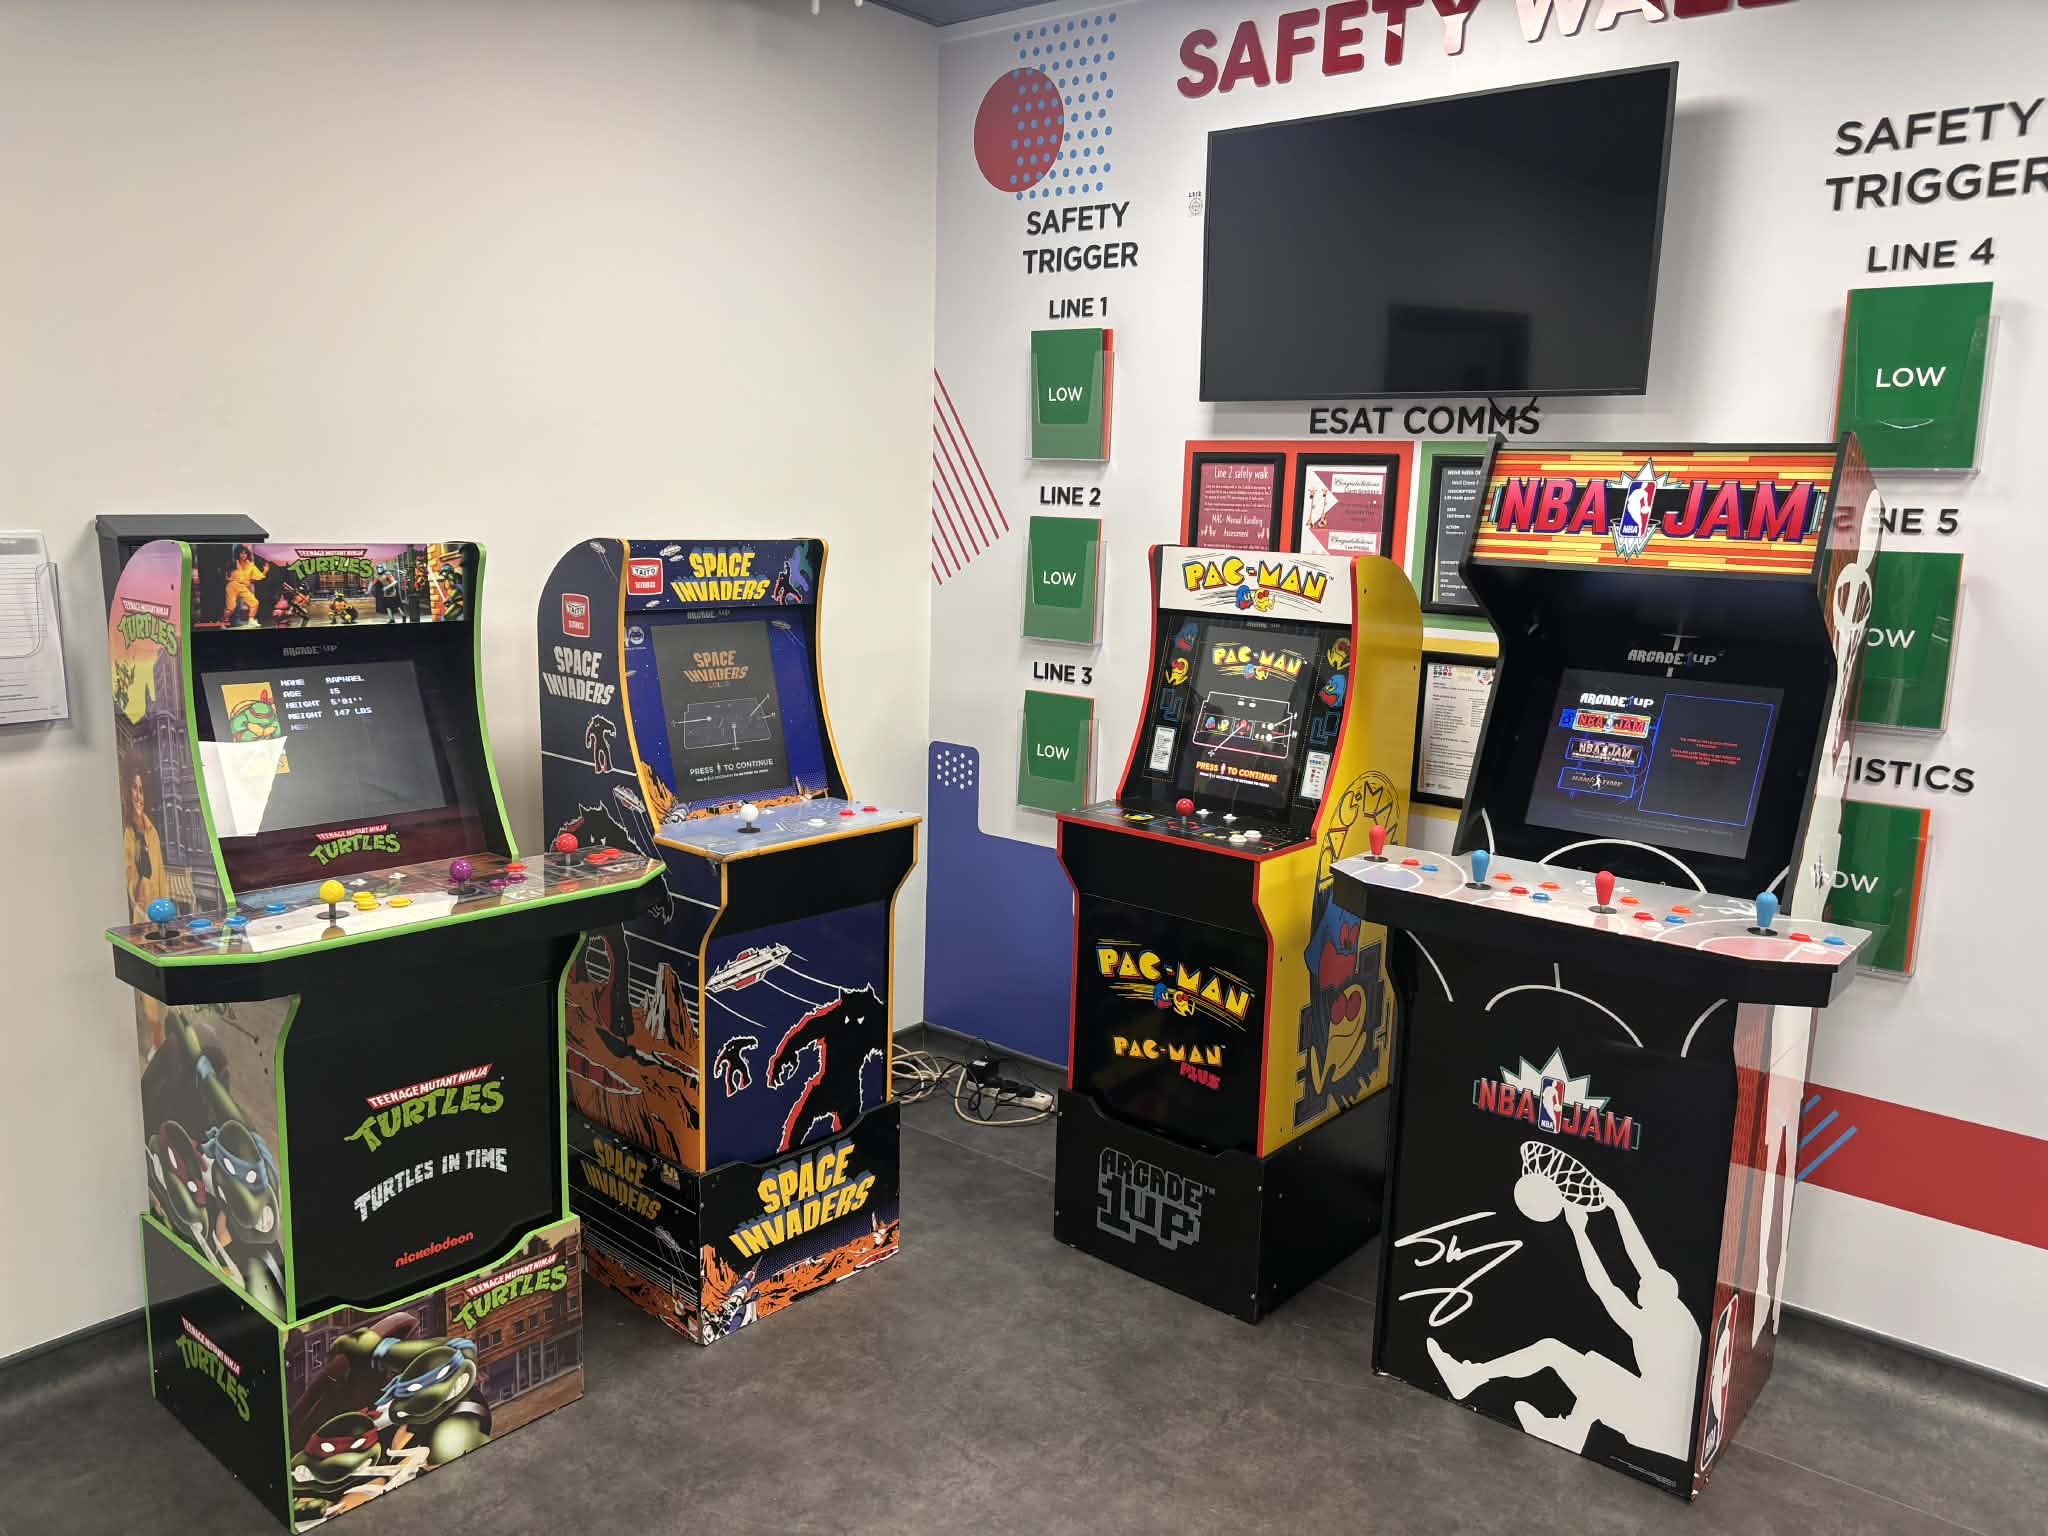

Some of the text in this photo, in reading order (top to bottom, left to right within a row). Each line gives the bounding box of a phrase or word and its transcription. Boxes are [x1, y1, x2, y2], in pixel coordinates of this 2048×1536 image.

[1177, 0, 1480, 99] SAFETY
[1835, 98, 2045, 156] SAFETY
[1826, 156, 2048, 212] TRIGGER
[1026, 202, 1130, 236] SAFETY
[1023, 242, 1139, 274] TRIGGER
[1868, 237, 1994, 272] LINE 4
[1049, 297, 1108, 319] LINE 1
[1876, 366, 1946, 388] LOW
[1048, 387, 1082, 402] LOW
[1309, 406, 1540, 435] ESAT COMMS
[1040, 486, 1101, 506] LINE 2
[1497, 478, 1815, 544] NBA JAM
[1622, 525, 1639, 534] NBA
[1937, 508, 1959, 534] 5
[288, 556, 374, 580] TURTLES
[634, 568, 656, 577] TAITO
[688, 551, 756, 578] SPACE
[1043, 571, 1076, 586] LOW
[1182, 556, 1327, 603] PAC-MAN
[670, 578, 771, 603] INVADERS
[117, 612, 178, 657] TURTLES
[1866, 628, 1916, 649] OW
[553, 645, 603, 678] SPACE
[683, 666, 749, 683] INVADERS
[693, 650, 737, 668] SPACE
[1033, 661, 1092, 684] LINE 3
[1212, 645, 1304, 674] PAC-MAN
[283, 690, 302, 698] AGE
[326, 676, 366, 684] RAPHAEL
[542, 671, 616, 706] INVADERS
[286, 700, 320, 708] HEIGHT
[334, 708, 350, 716] 147
[1579, 714, 1646, 733] NBA JAM
[1036, 744, 1069, 760] LOW
[1579, 742, 1600, 755] NBA
[690, 766, 714, 775] PRESS
[736, 758, 774, 770] CONTINUE
[1196, 761, 1219, 772] PRESS
[1227, 766, 1238, 776] TO
[1239, 769, 1278, 784] CONTINUE
[1854, 757, 1975, 794] ISTICS
[308, 834, 400, 865] TURTLES
[1832, 871, 1878, 892] OW
[1096, 945, 1250, 1022] PAC-MAN
[1112, 1035, 1222, 1067] PAC-MAN
[367, 1065, 490, 1108] TEENAGE MUTANT NINJA
[344, 1081, 504, 1152] TURTLES
[1478, 1078, 1633, 1150] NBA JAM
[593, 1138, 648, 1188] SPACE
[353, 1148, 508, 1222] TURTLES IN TIME
[580, 1160, 663, 1220] INVADERS
[757, 1143, 855, 1216] SPACE
[1099, 1148, 1203, 1210] ARCADE
[729, 1174, 876, 1258] INVADERS
[394, 1231, 474, 1268] nickelodeon
[465, 1254, 558, 1297] TEENAGE MUTANT NINJA
[452, 1264, 568, 1331] TURTLES
[176, 1334, 250, 1422] TURTLES
